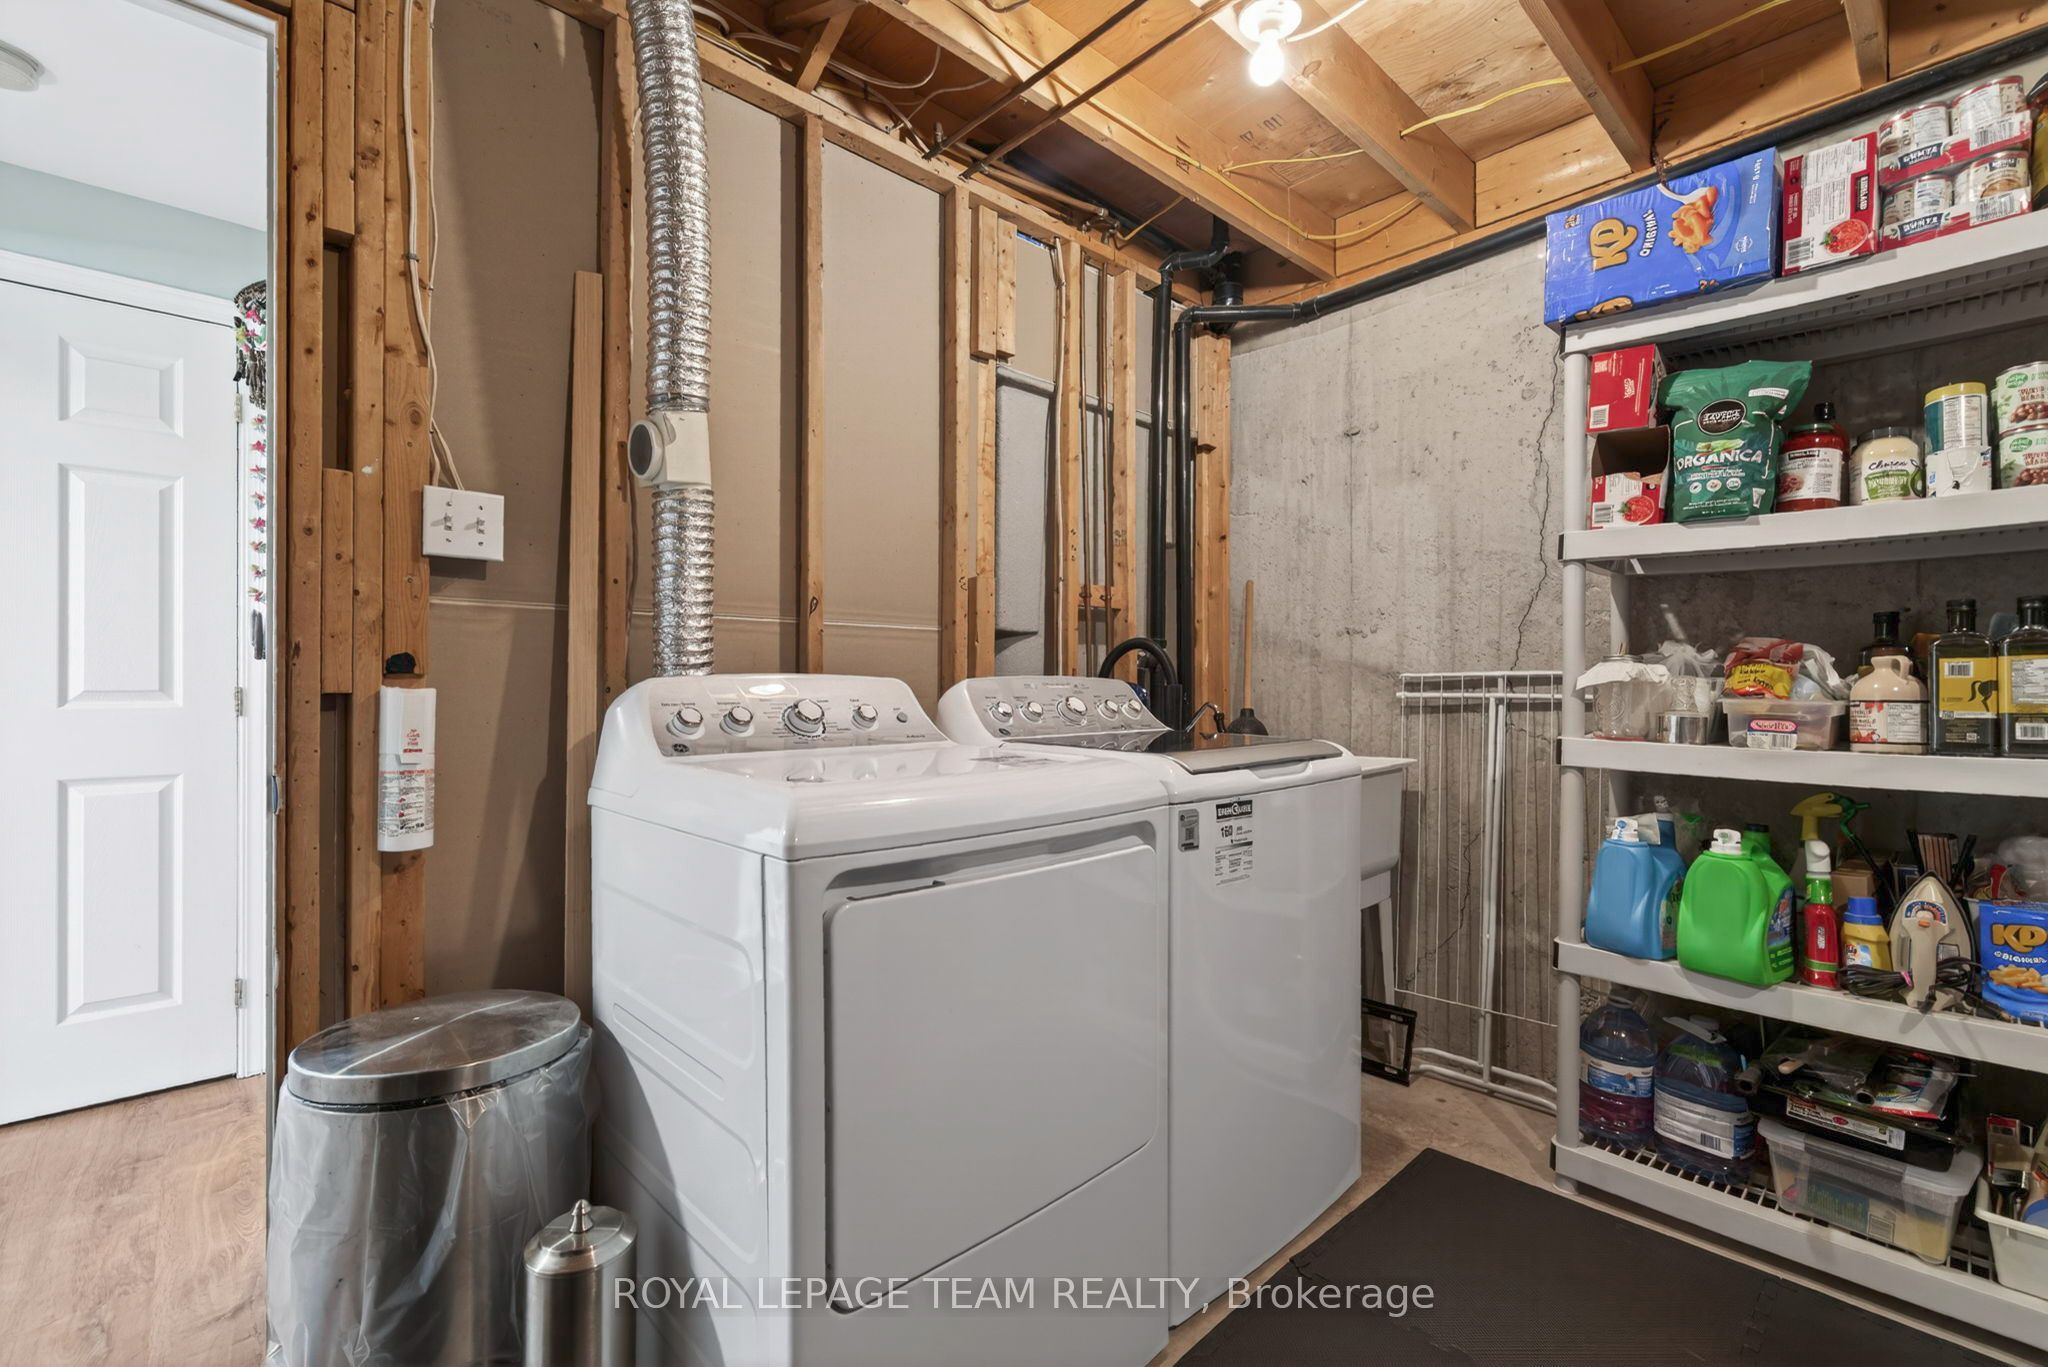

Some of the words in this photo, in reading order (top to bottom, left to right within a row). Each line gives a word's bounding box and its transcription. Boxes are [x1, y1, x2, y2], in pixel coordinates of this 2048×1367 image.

[1590, 217, 1639, 272] KD
[1639, 208, 1658, 258] ORIGINAL
[1676, 449, 1763, 472] ORGANICA
[1991, 923, 2048, 954] KD
